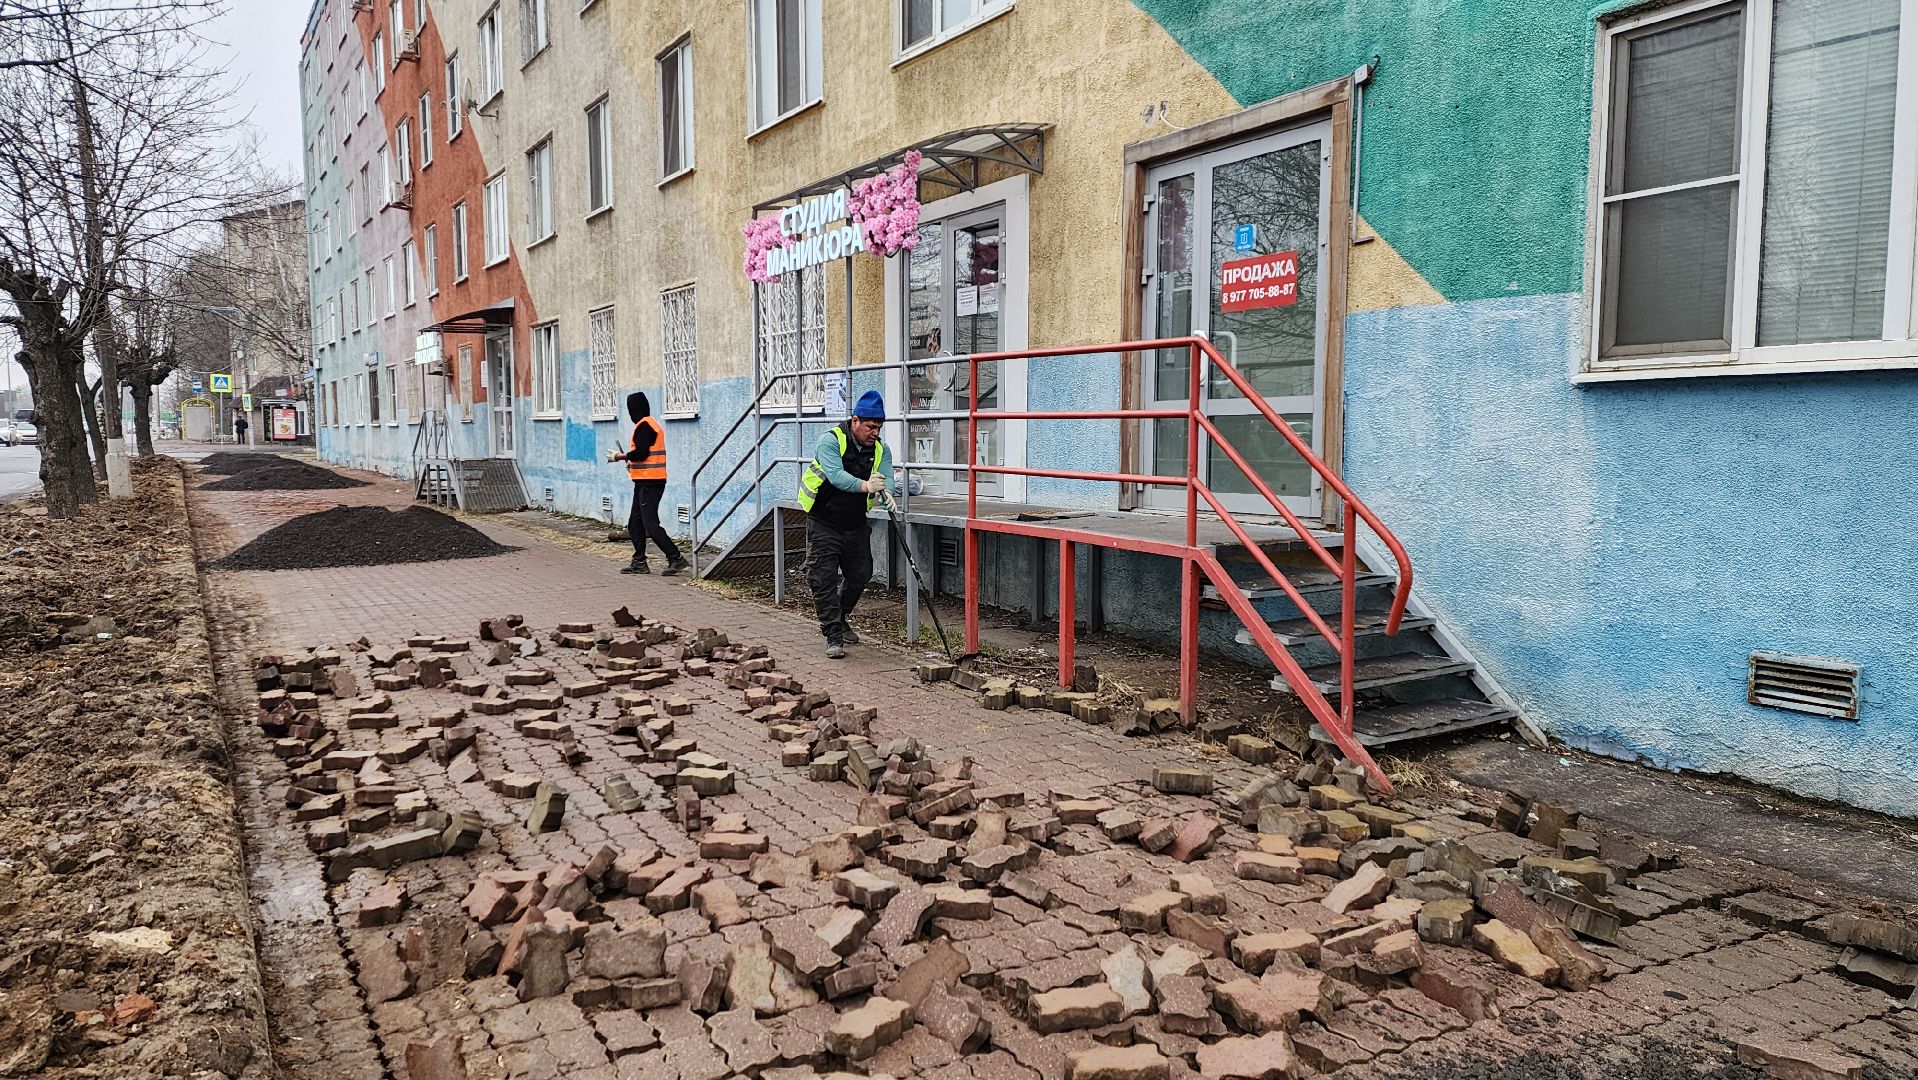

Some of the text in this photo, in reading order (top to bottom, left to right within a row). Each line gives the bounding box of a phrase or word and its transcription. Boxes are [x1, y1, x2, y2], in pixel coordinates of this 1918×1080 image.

[780, 187, 847, 237] СТУДИЯ
[766, 222, 865, 277] МАНИКЮРА
[1223, 259, 1295, 284] ПРОДАЖА
[1222, 283, 1295, 304] 8 977 705-88-87
